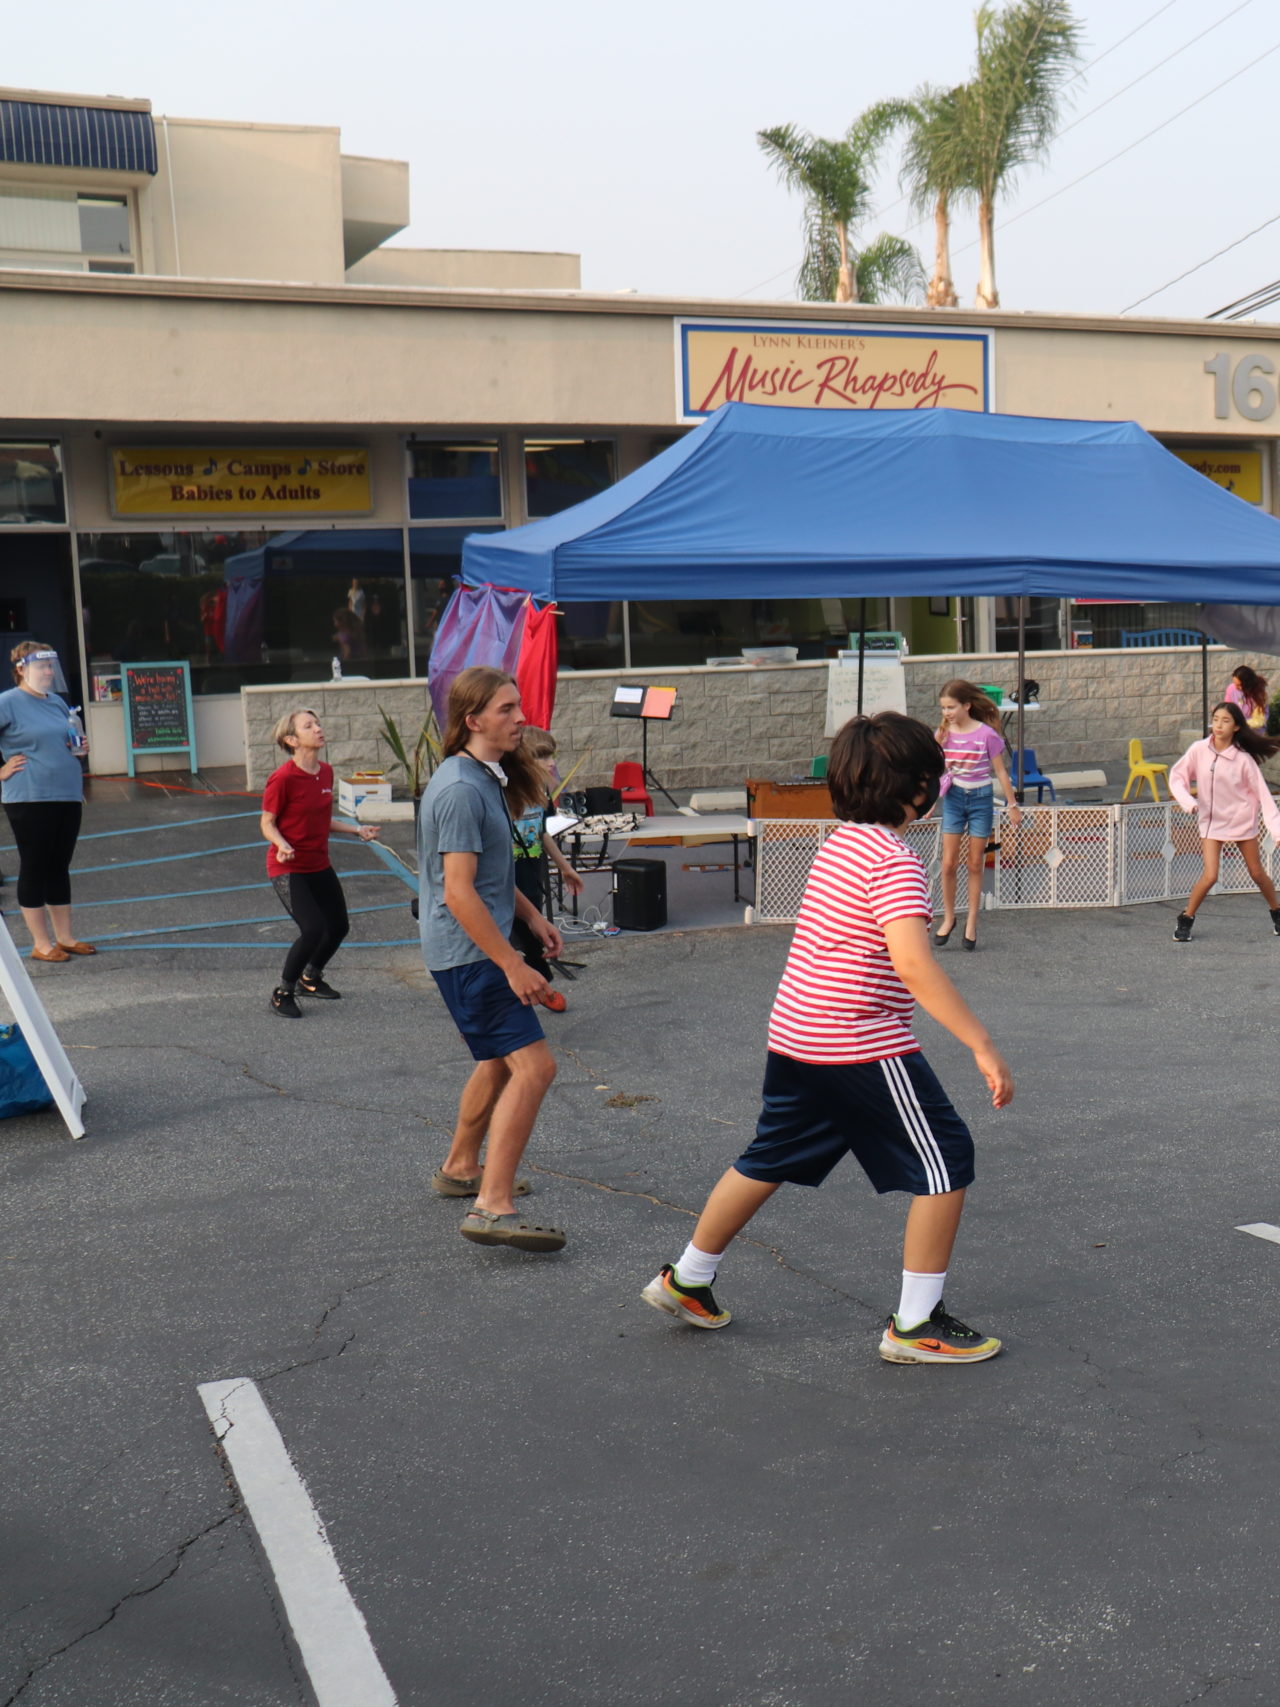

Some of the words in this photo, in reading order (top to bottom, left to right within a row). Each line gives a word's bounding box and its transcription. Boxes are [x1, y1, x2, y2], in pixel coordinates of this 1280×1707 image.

[753, 334, 791, 348] LYNN
[797, 336, 865, 351] KLEINER'S
[699, 347, 814, 413] Music
[815, 350, 978, 409] Rhapsody
[119, 459, 194, 477] Lessons
[227, 459, 292, 480] Camps
[317, 460, 366, 476] Store
[171, 484, 233, 501] Babies
[238, 485, 256, 500] to
[262, 484, 321, 500] Adults
